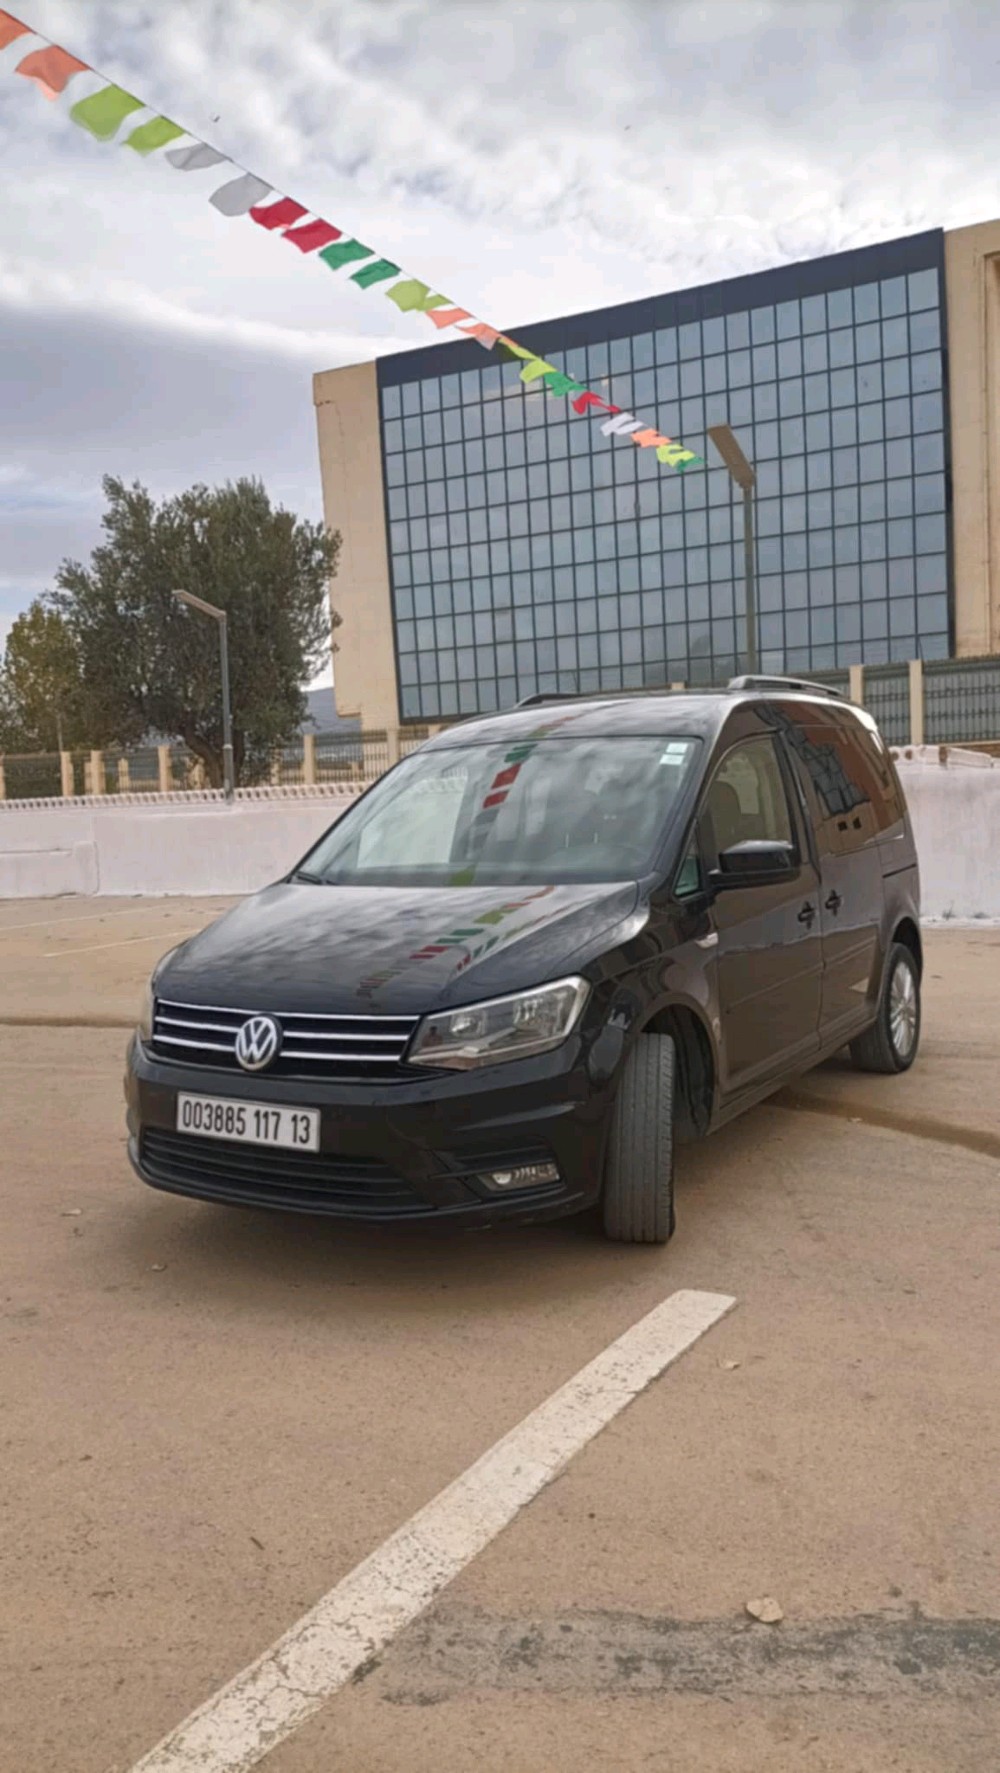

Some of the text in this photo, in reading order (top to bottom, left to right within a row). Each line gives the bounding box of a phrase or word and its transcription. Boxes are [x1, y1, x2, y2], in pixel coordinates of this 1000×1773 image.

[183, 1100, 311, 1144] 003885 117 13
